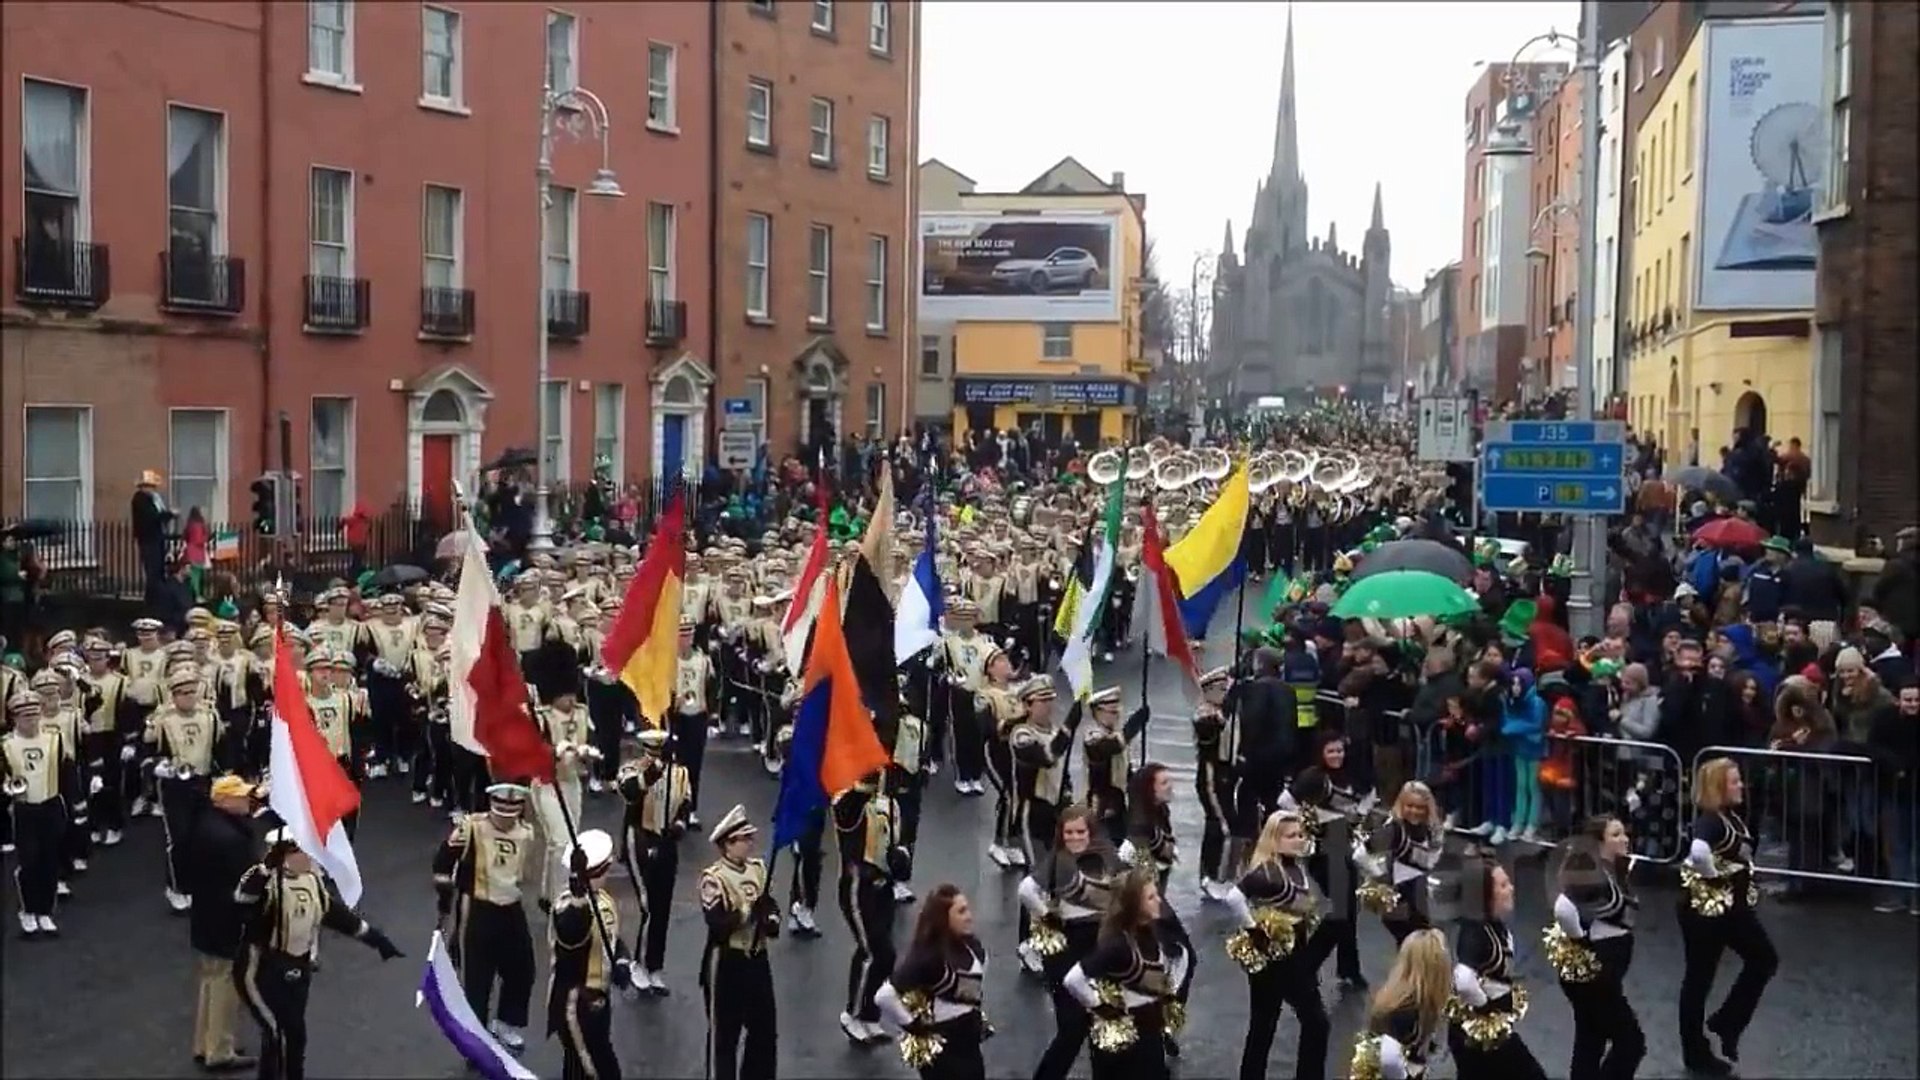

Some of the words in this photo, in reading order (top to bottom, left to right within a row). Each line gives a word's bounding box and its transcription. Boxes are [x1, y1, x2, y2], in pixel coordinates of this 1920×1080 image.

[974, 239, 992, 248] SEAT
[994, 239, 1015, 248] LEON
[1539, 425, 1569, 440] J35
[1538, 486, 1549, 500] P
